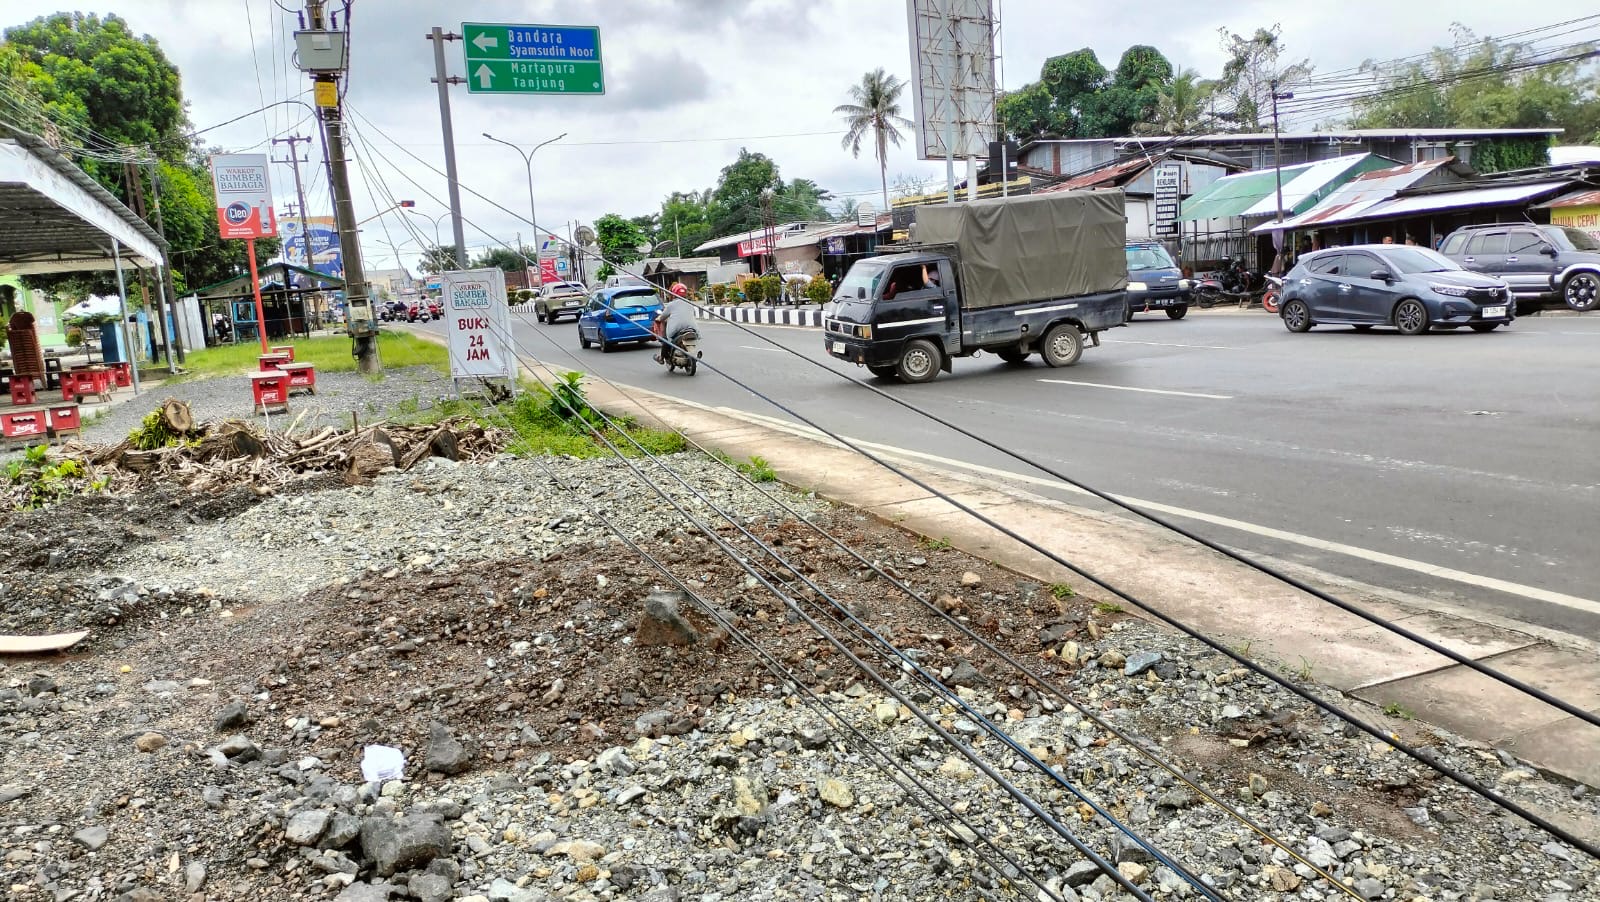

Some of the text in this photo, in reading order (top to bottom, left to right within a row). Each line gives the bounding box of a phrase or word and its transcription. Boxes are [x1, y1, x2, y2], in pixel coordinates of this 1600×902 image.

[508, 29, 563, 44] Bandara
[510, 45, 594, 58] Syamsudin Noor
[511, 62, 575, 76] Martapura
[513, 77, 565, 90] Tanjung
[220, 173, 262, 182] SUMBER
[220, 181, 265, 190] BAHAGIA
[229, 208, 247, 219] Cleo
[1577, 214, 1598, 228] CEPAT
[469, 335, 484, 347] 24
[466, 348, 490, 361] JAM
